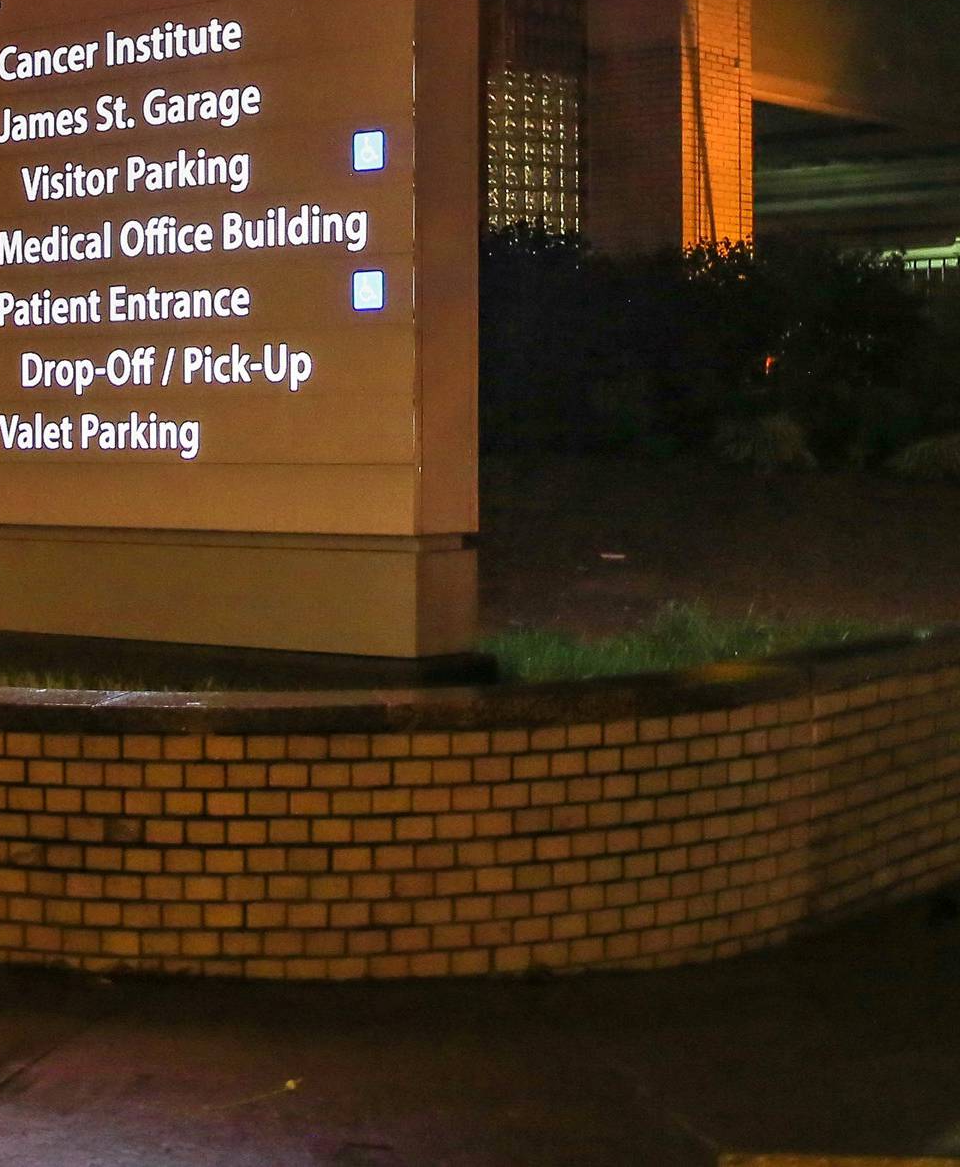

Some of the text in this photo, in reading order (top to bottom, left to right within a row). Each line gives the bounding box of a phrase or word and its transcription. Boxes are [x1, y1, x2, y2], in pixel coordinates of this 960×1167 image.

[106, 18, 242, 66] Institute
[96, 95, 136, 132] St.
[143, 85, 261, 127] Garage
[21, 148, 250, 201] Visitor Parking
[120, 216, 213, 258] Office
[223, 204, 368, 252] Building
[109, 285, 250, 323] Entrance
[21, 343, 313, 396] Drop-Off / Pick-Up
[81, 411, 200, 459] Parking
